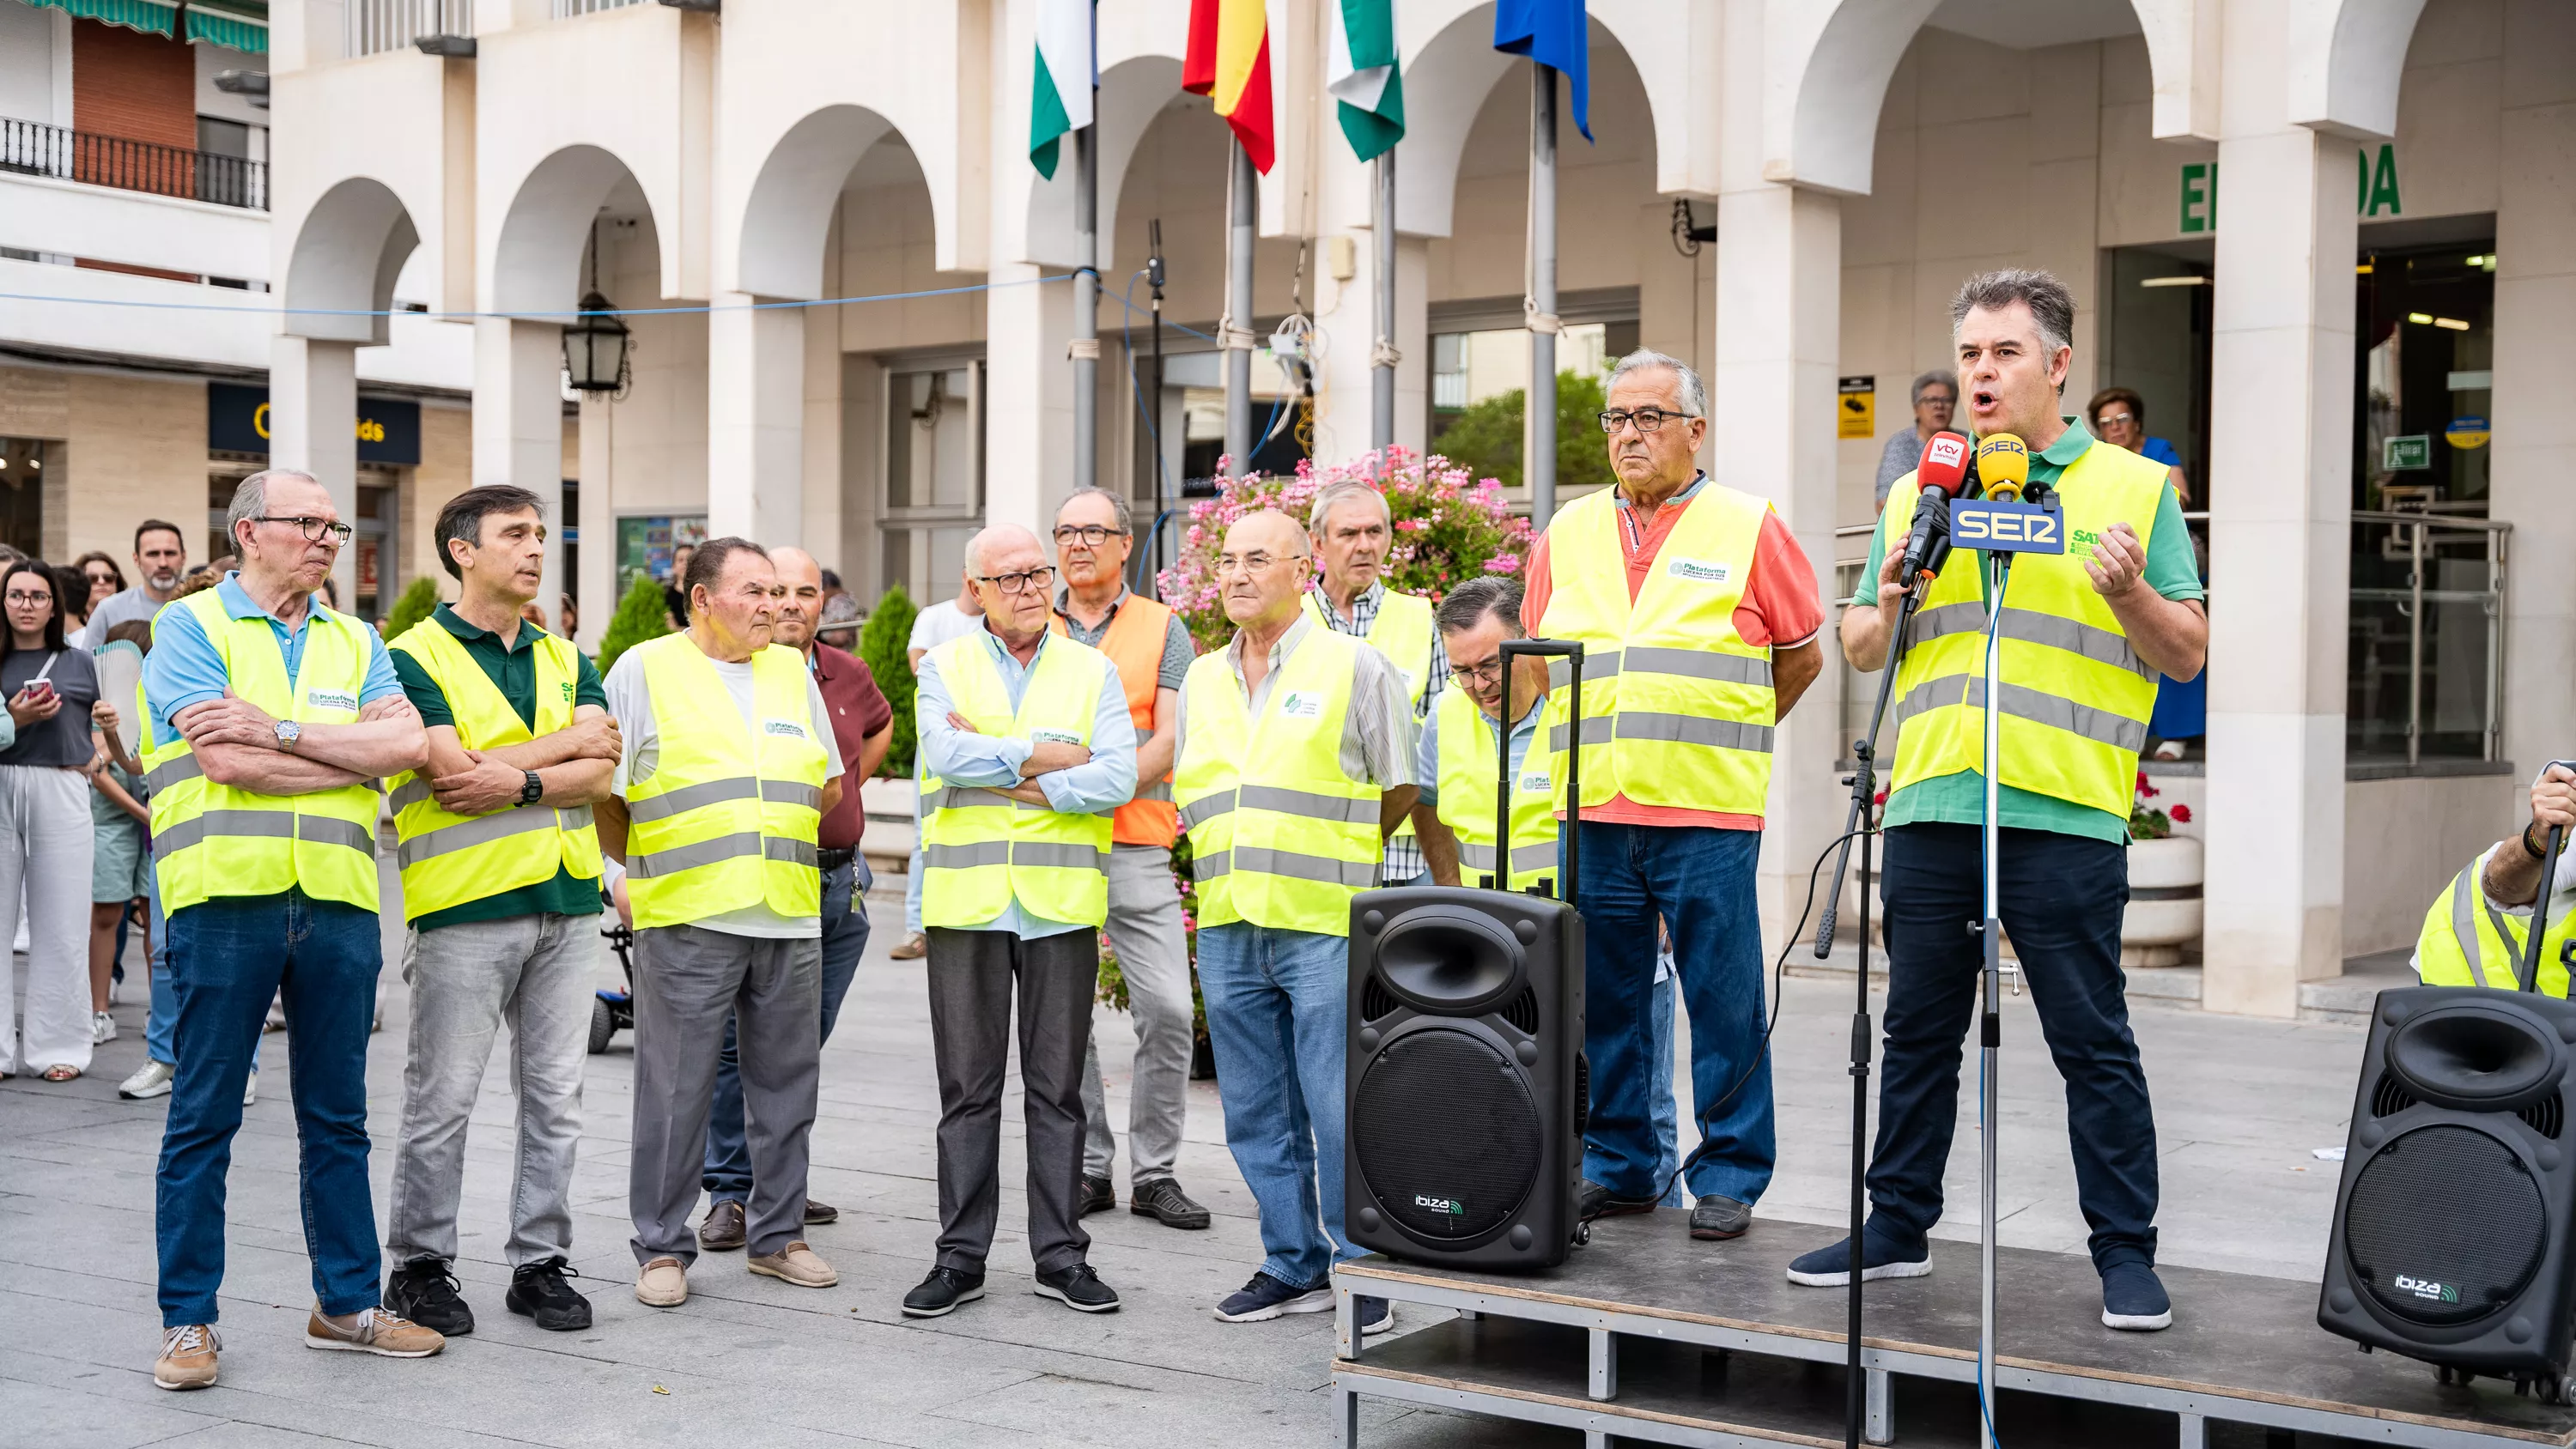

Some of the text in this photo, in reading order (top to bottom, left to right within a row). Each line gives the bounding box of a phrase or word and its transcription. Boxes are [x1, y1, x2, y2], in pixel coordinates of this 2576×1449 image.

[1937, 444, 1959, 455] vtv
[1981, 440, 2025, 459] SER
[1958, 510, 2057, 543] SER
[1684, 563, 1726, 574] Plataforma
[1043, 732, 1079, 743] Plataforma
[1415, 1194, 1449, 1209] ibiza
[2395, 1272, 2441, 1294] ibiza
